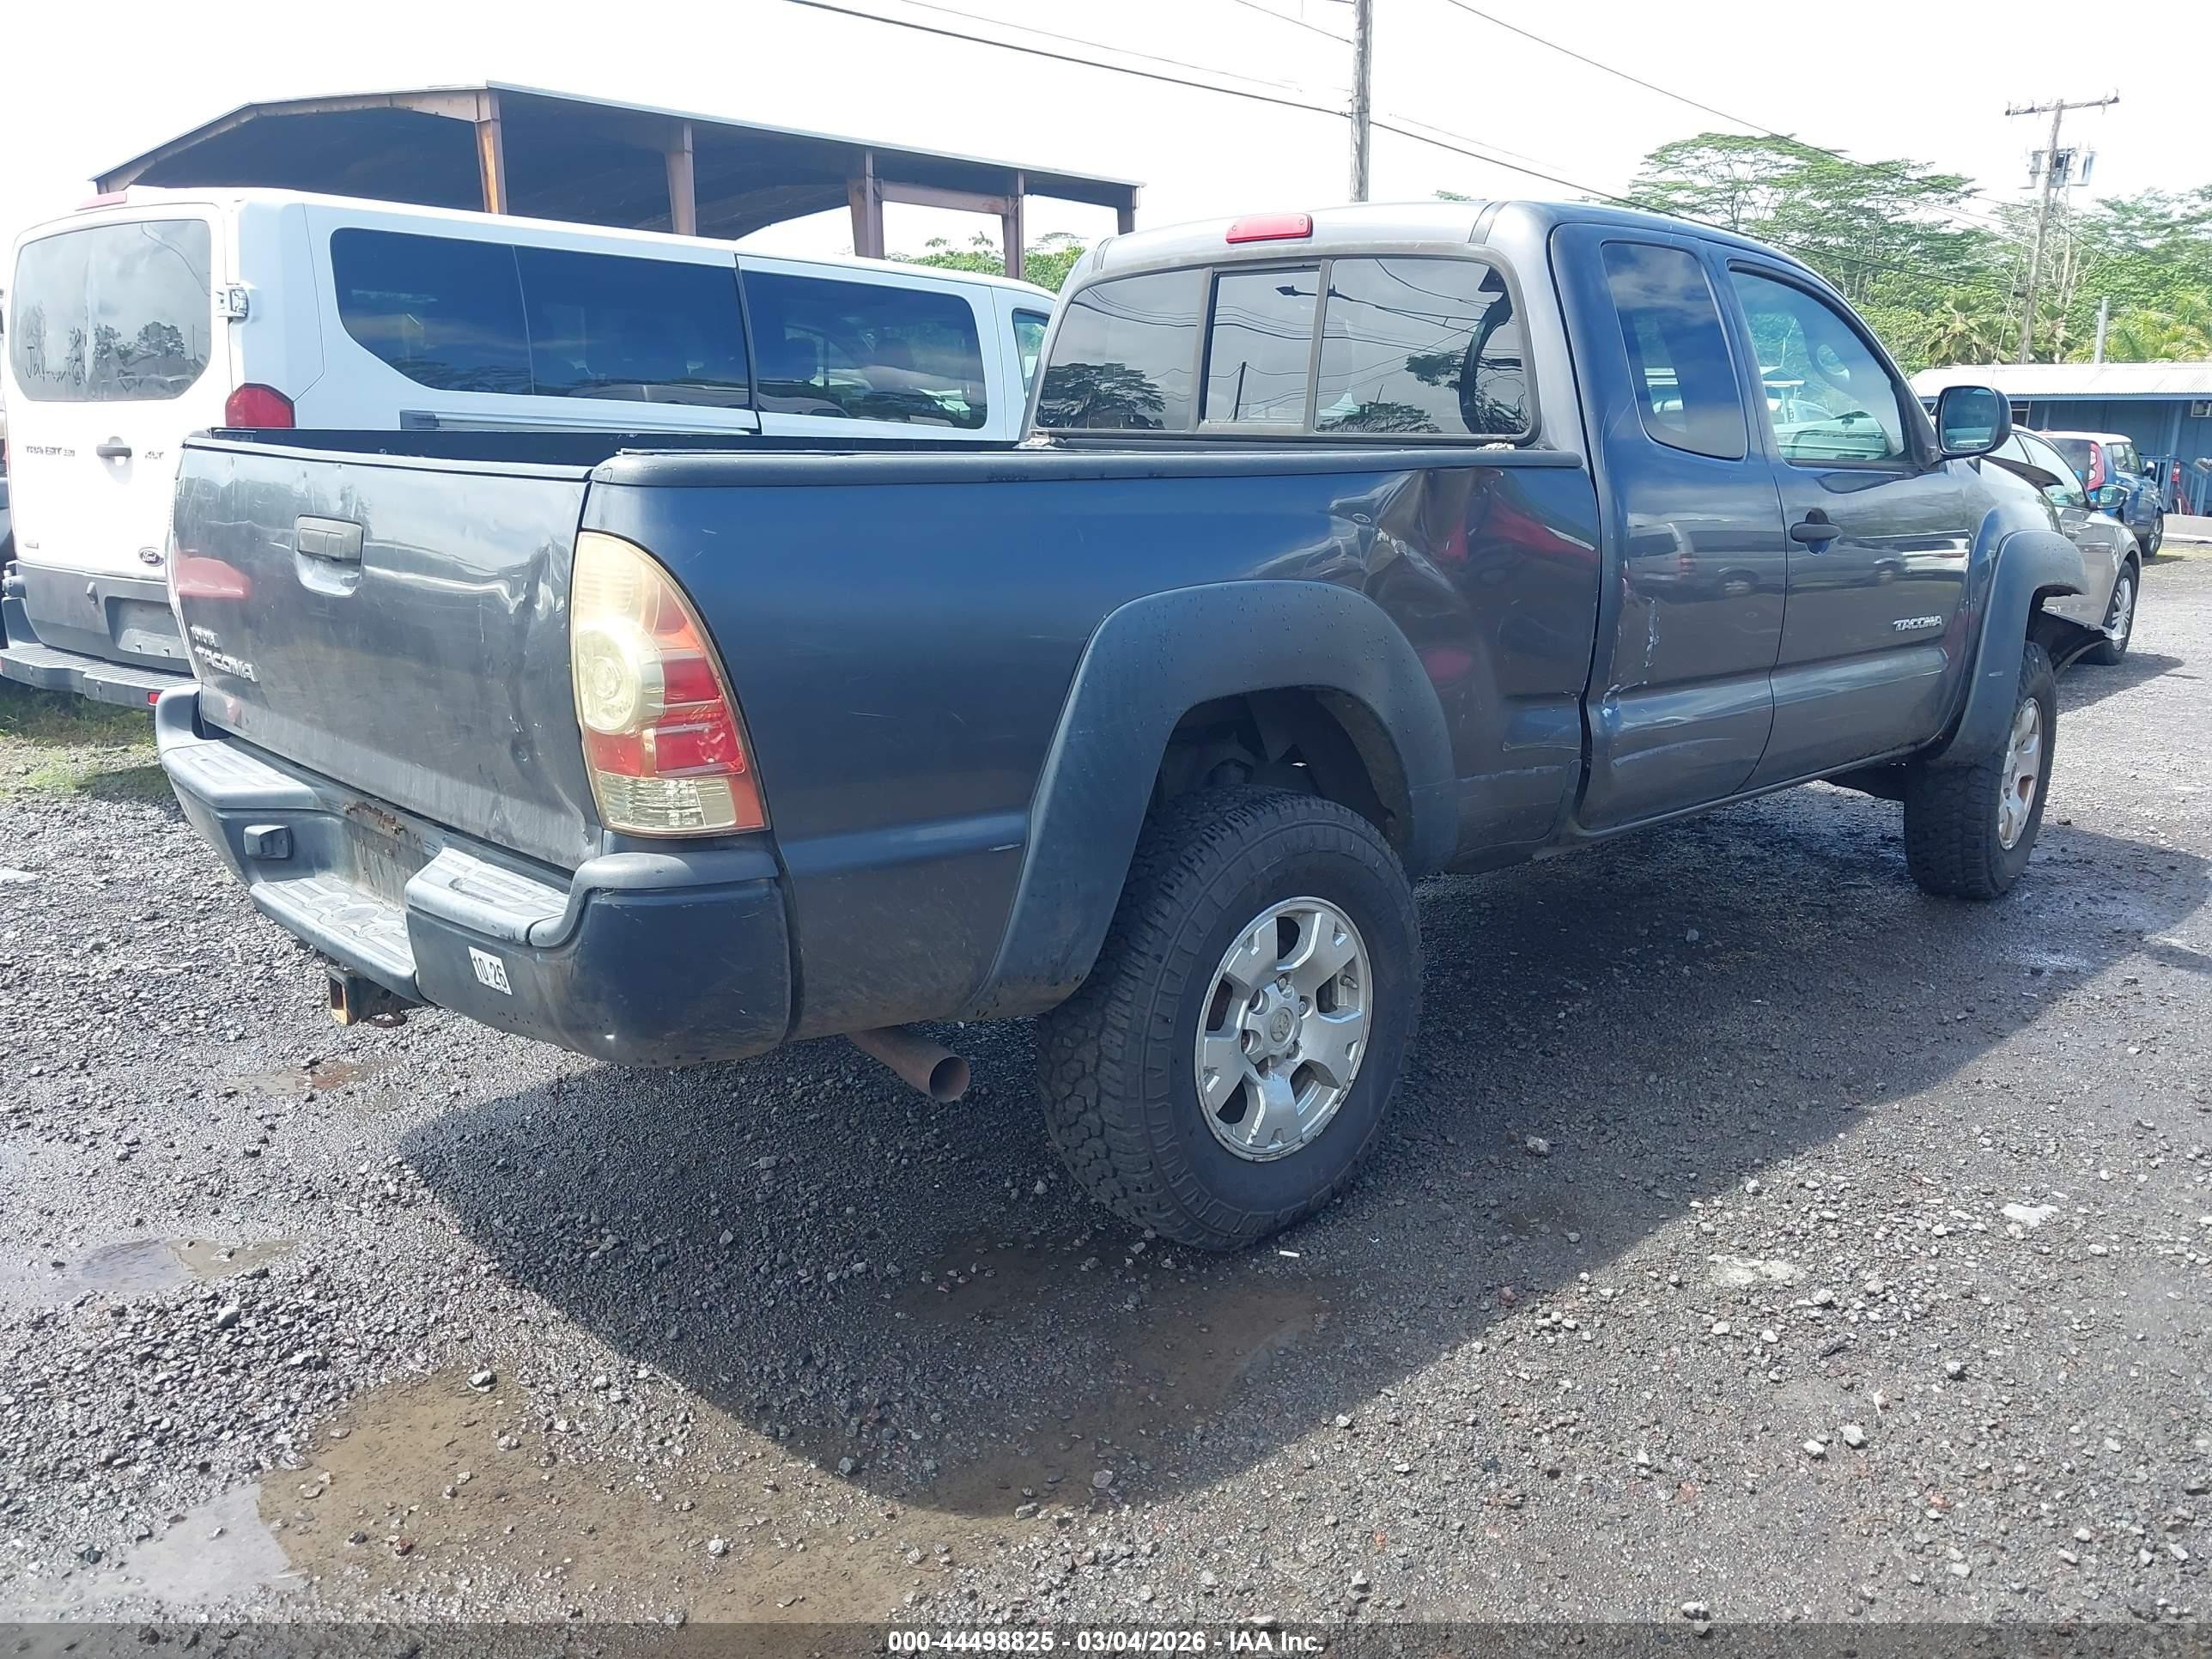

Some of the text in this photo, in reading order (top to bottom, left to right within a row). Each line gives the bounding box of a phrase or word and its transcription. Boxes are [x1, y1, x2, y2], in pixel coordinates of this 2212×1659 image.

[1893, 615, 1942, 631] TACOMA
[194, 646, 259, 683] TACOMA
[472, 955, 507, 989] 10 26
